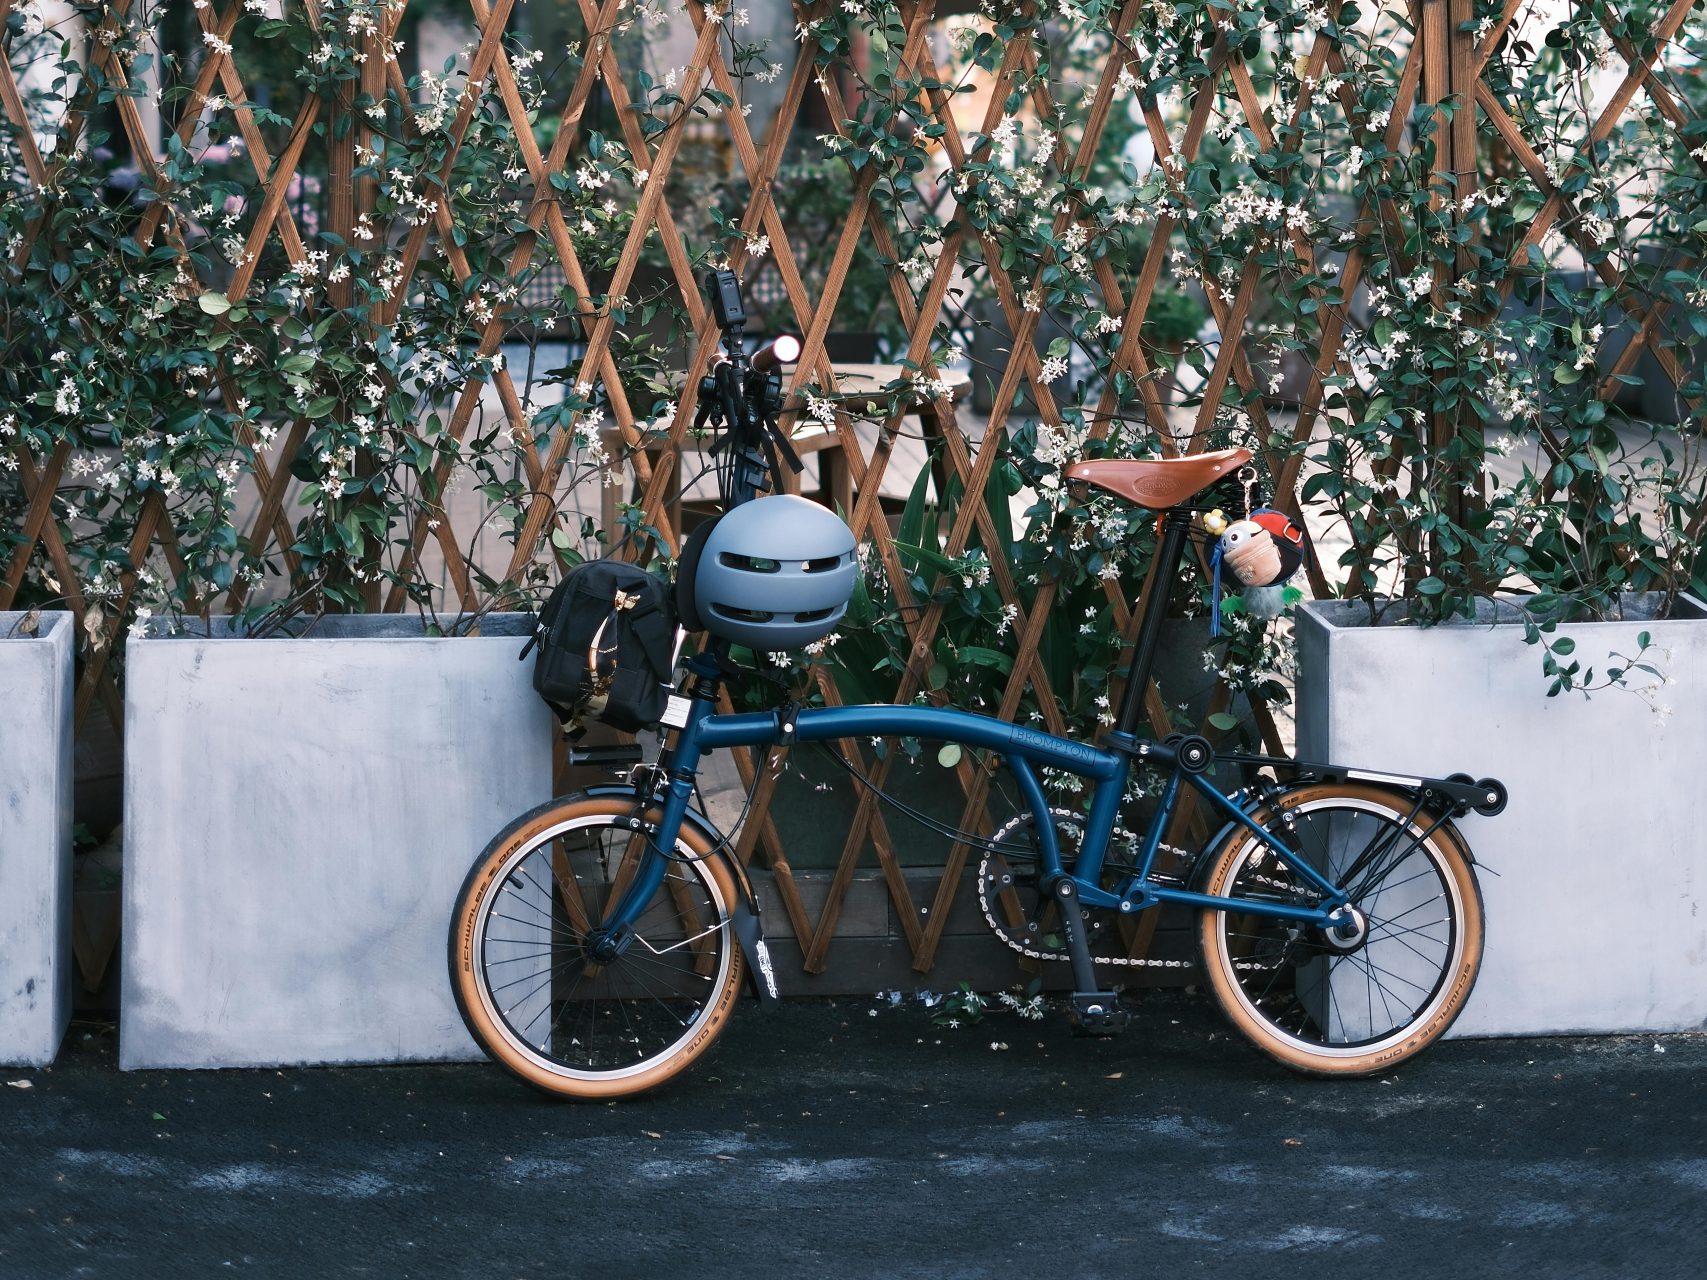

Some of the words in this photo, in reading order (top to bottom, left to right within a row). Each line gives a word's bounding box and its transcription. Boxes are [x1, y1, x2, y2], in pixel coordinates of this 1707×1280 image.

[1016, 728, 1091, 760] BROMPTON
[463, 881, 488, 973] SCHWALBE
[1419, 962, 1471, 1040] SCHWALBE
